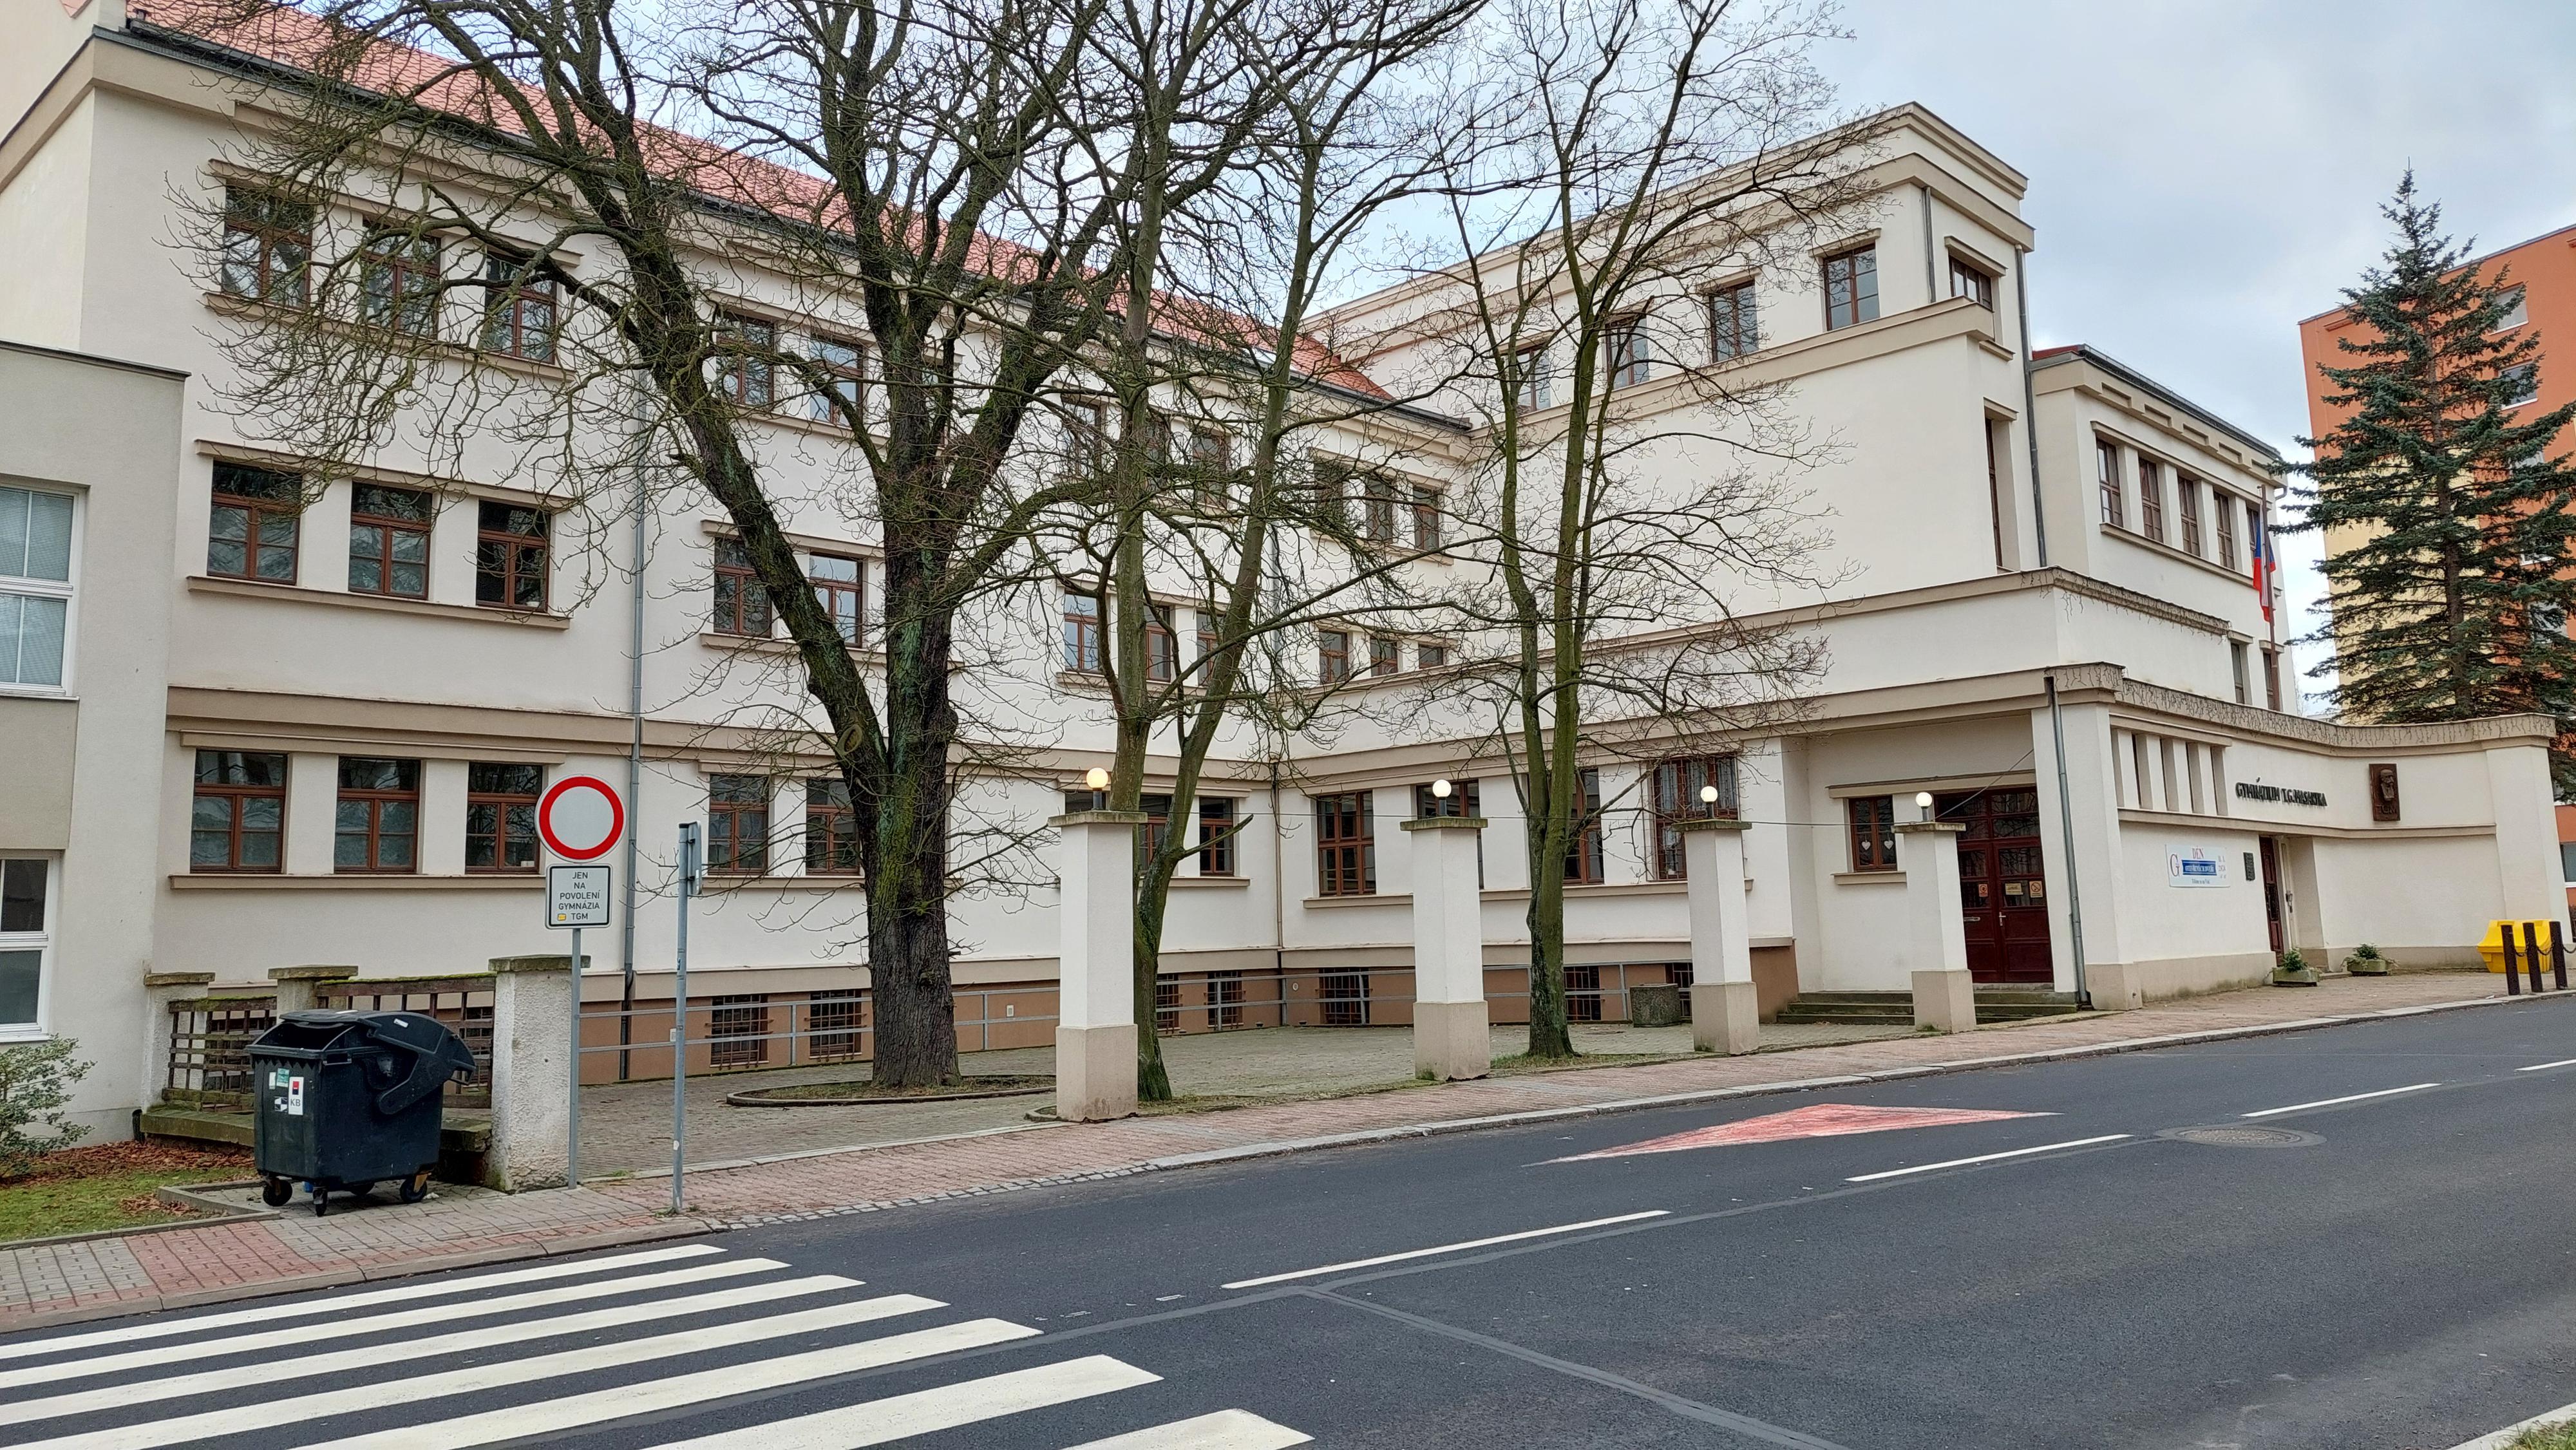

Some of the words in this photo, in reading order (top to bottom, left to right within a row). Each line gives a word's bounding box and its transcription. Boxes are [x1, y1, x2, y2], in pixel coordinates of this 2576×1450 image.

[560, 889, 601, 899] POVOLENÍ
[558, 900, 600, 910] GYMNÁZIA
[290, 1098, 301, 1107] KB
